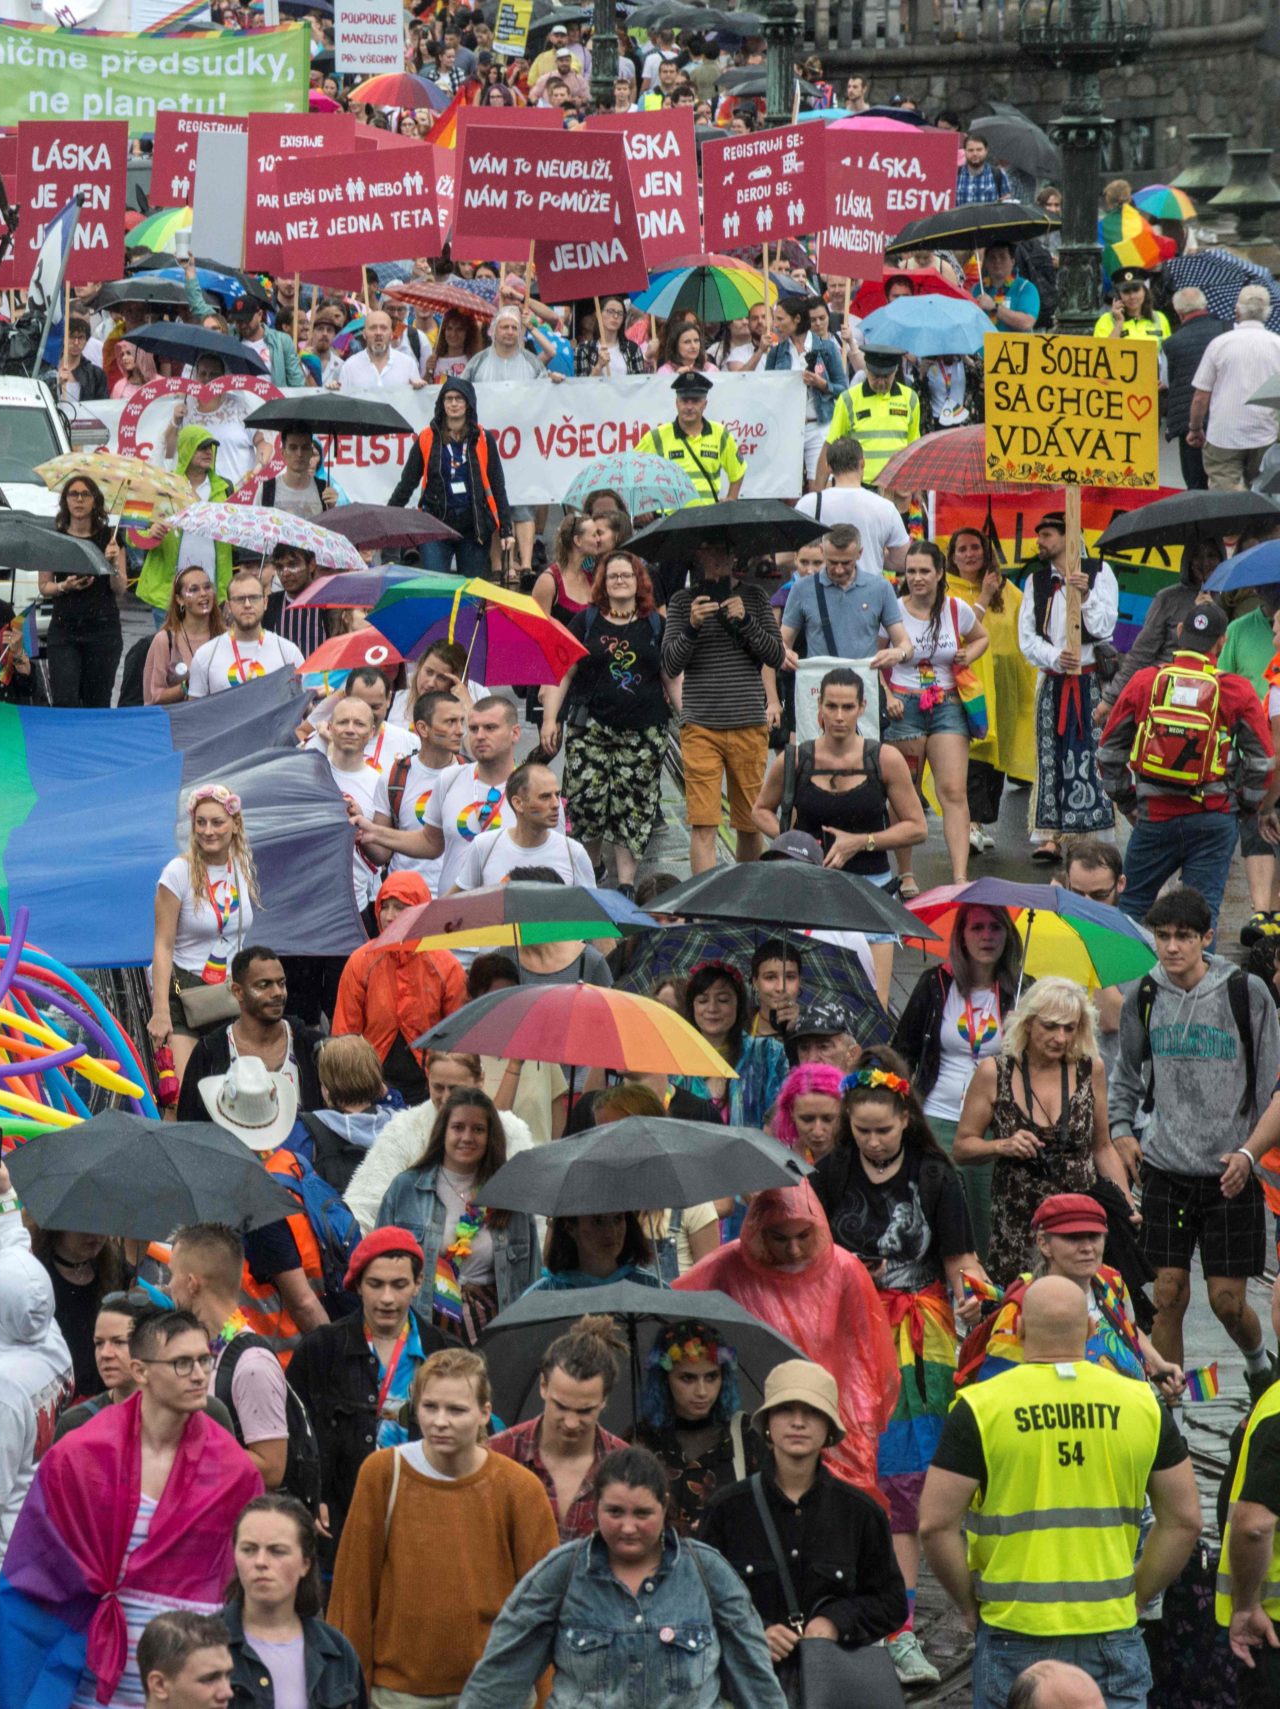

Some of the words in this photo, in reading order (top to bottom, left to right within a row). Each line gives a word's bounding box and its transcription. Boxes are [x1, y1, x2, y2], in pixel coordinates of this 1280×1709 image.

[340, 12, 397, 26] PODPORUJE
[341, 33, 398, 45] MANŽELSTVÍ
[101, 48, 295, 83] předsudky,
[359, 53, 398, 65] VŠECHNY
[29, 89, 69, 113] ne
[83, 87, 227, 120] planetu!
[31, 139, 112, 172] LÁSKA
[280, 135, 325, 148] EXISTUJE
[723, 136, 783, 161] REGISTRUJÍ
[786, 132, 804, 149] SE:
[469, 152, 508, 176] VÁM
[513, 157, 532, 176] TO
[536, 157, 613, 182] NEUBLÍŽÍ,
[30, 183, 58, 209] JE
[283, 188, 316, 208] LEPŠÍ
[318, 183, 344, 203] DVĚ
[369, 181, 403, 199] NEBO
[464, 184, 508, 210] NÁM
[513, 189, 533, 208] TO
[538, 188, 611, 213] POMŮŽE
[639, 170, 683, 199] JEN
[736, 184, 771, 205] BEROU
[775, 181, 793, 196] SE:
[835, 193, 842, 215] 1
[842, 188, 875, 222] LÁSKA,
[886, 188, 952, 212] ELSTVÍ
[29, 222, 110, 251] JNA
[286, 217, 319, 241] NEŽ
[327, 212, 384, 237] JEDNA
[390, 207, 434, 231] TETA
[636, 208, 685, 240] DNA
[822, 229, 828, 247] 1
[829, 224, 884, 254] MANŽELSTVÍ
[549, 237, 629, 273] JEDNA
[988, 340, 1030, 376] AJ
[1035, 334, 1138, 384] ŠOHAJ
[534, 414, 650, 460] VŠECH
[737, 439, 758, 456] ér
[992, 416, 1142, 465] VDÁVAT
[1014, 1402, 1121, 1433] SECURITY
[1057, 1441, 1085, 1467] 54
